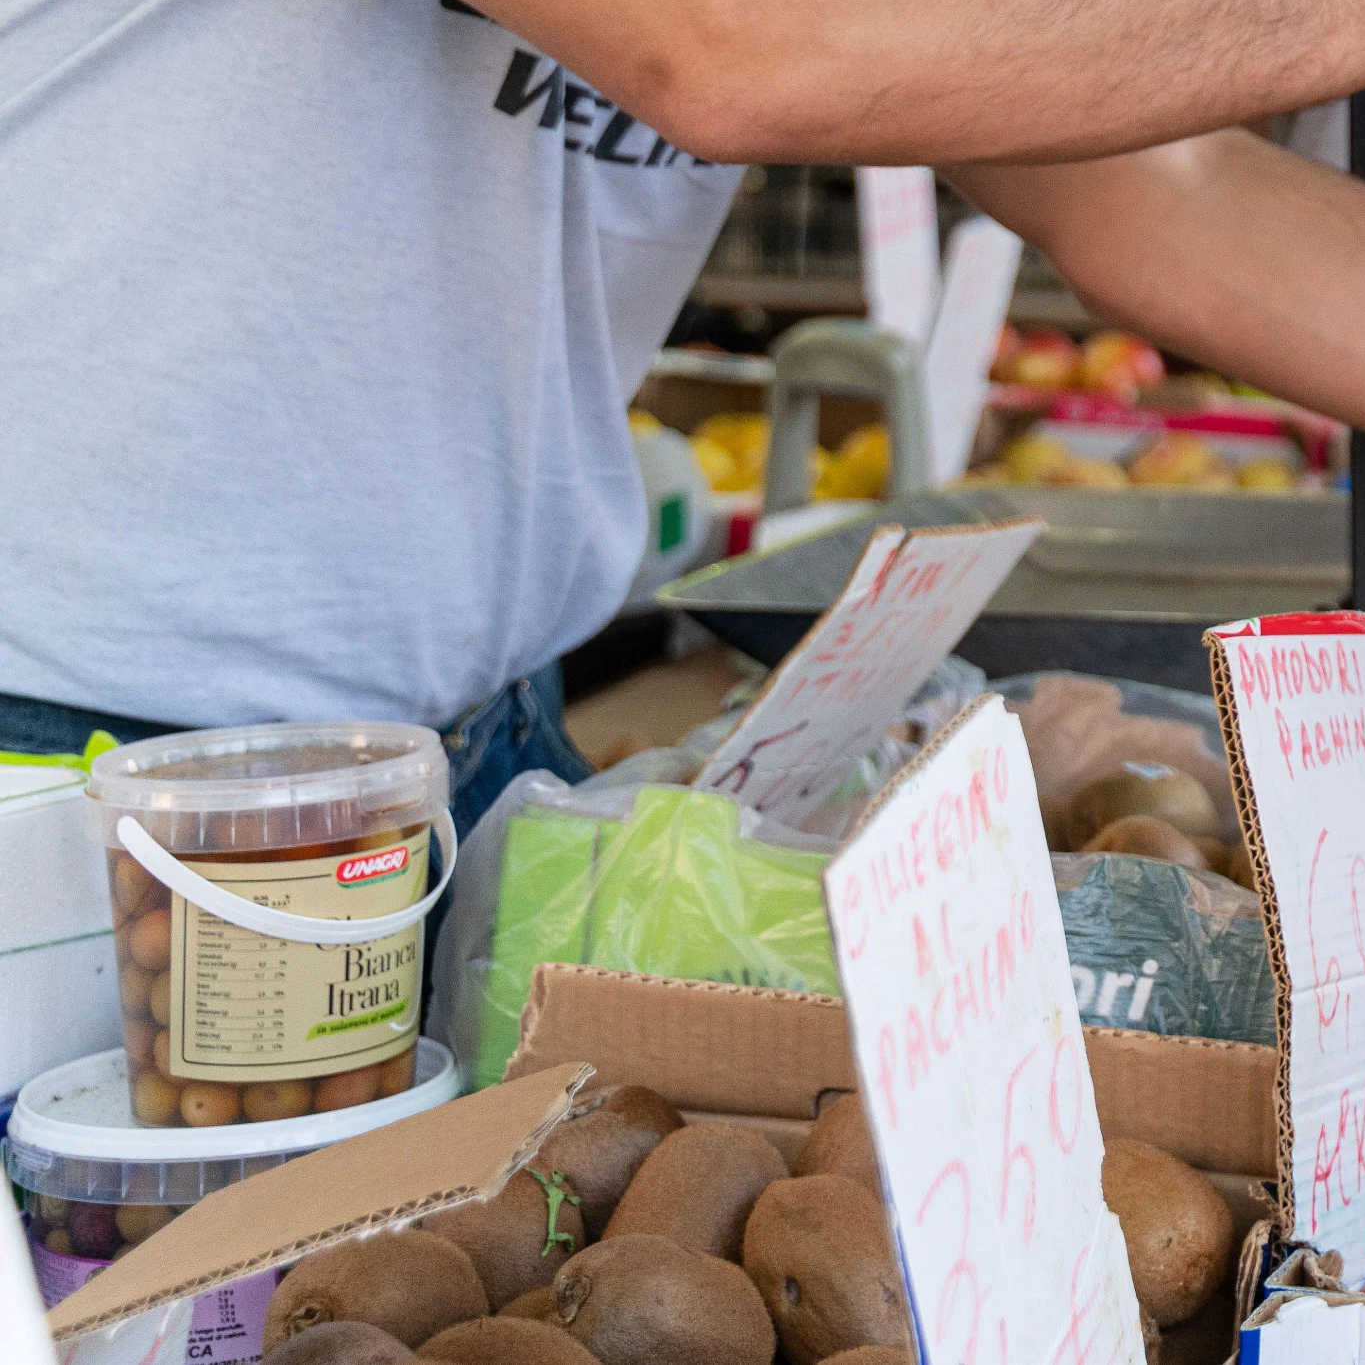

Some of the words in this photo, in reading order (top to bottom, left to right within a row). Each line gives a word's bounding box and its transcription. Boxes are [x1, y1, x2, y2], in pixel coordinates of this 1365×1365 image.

[1238, 638, 1363, 711] POMODORI
[342, 848, 407, 877] UNAGRI
[344, 941, 417, 982] Bianca
[325, 979, 400, 1017] Itrana
[876, 889, 1037, 1130] PACHINO
